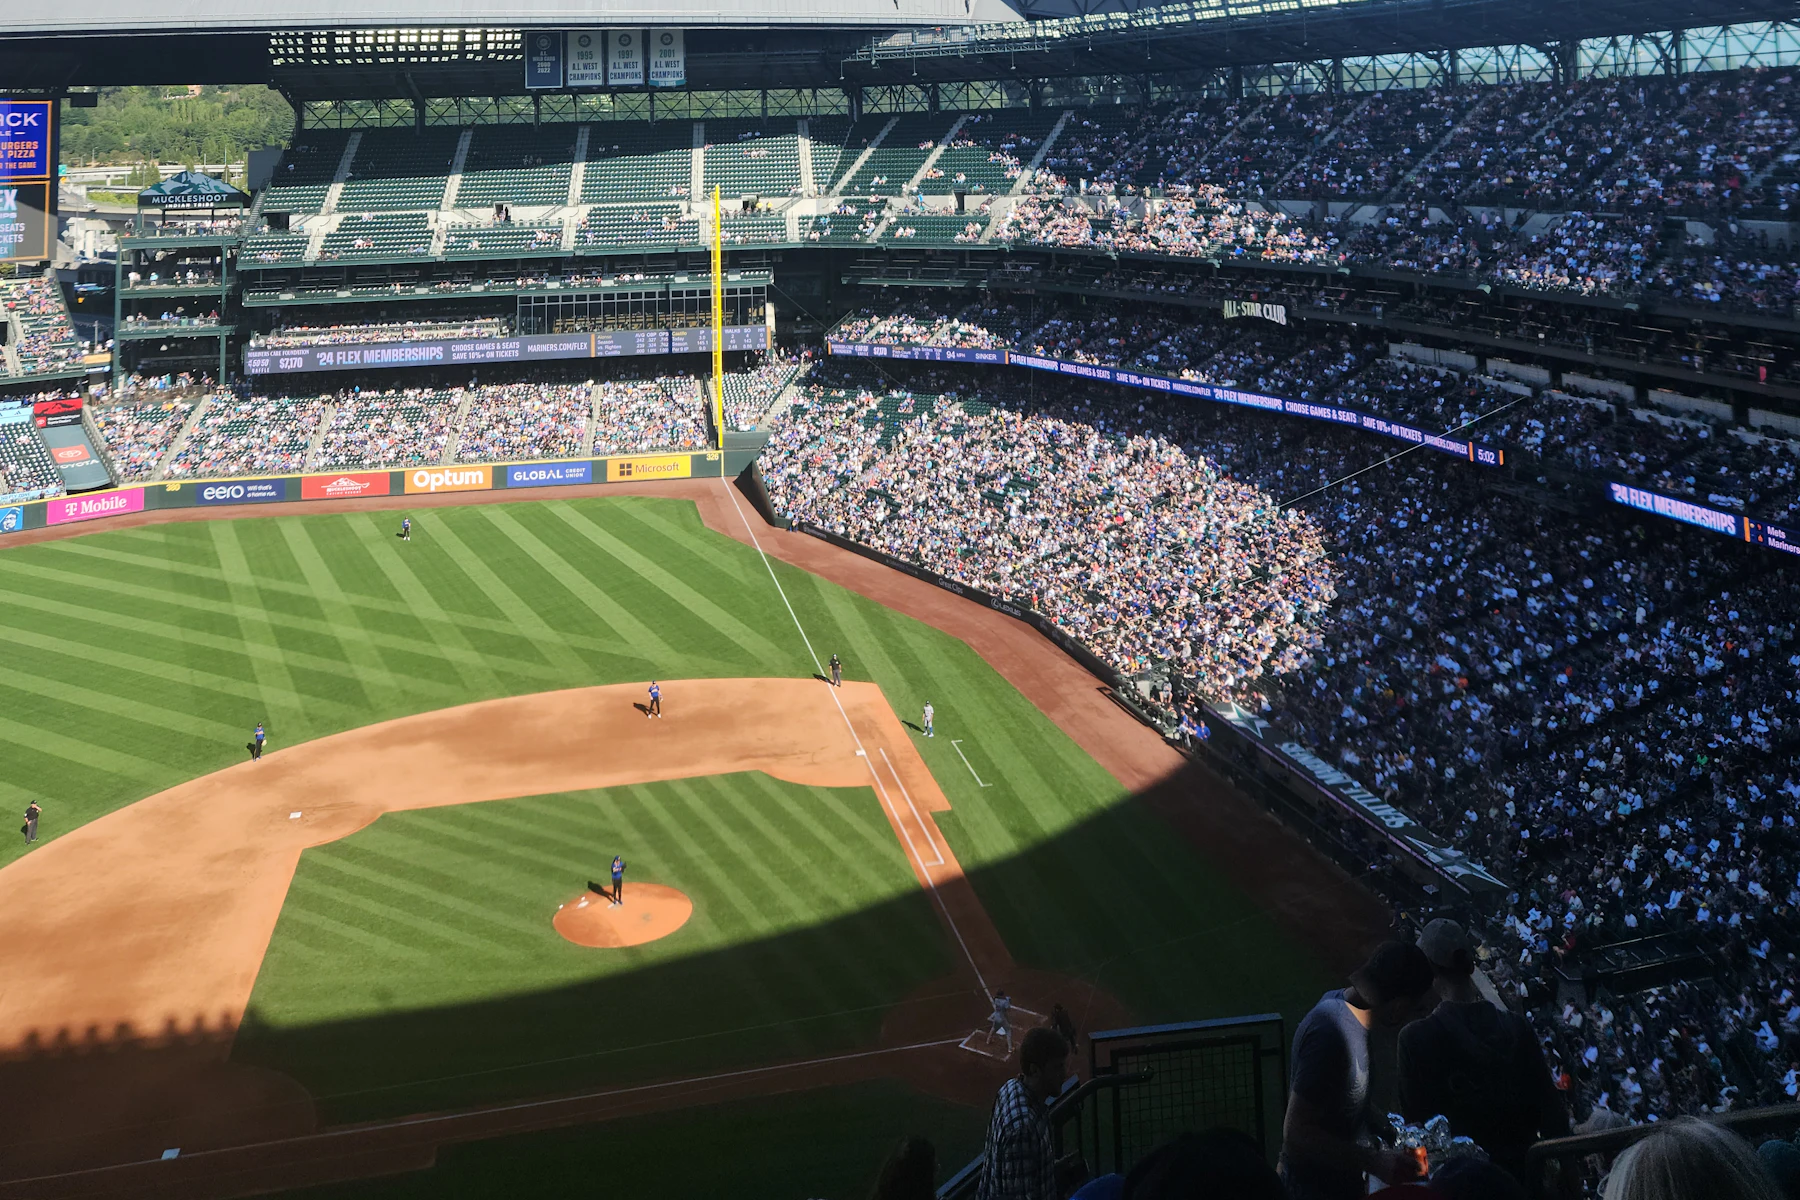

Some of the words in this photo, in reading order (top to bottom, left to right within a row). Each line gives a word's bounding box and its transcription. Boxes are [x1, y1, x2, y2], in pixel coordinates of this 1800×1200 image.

[577, 51, 593, 60] 1995
[618, 50, 633, 59] 1997
[659, 49, 675, 58] 2001
[583, 62, 598, 70] WEST
[623, 61, 638, 69] WEST
[664, 60, 680, 68] WEST
[569, 72, 601, 81] CHAMPIONS
[610, 71, 642, 80] CHAMPIONS
[651, 70, 683, 79] CHAMPIONS
[8, 150, 35, 158] PIZZA
[151, 194, 228, 204] MUCKLESHOOT
[1263, 303, 1287, 325] CLUB
[451, 344, 474, 352] CHOOSE
[475, 343, 495, 351] GAMES
[528, 342, 588, 352] MARINERS.COM/FLEX
[337, 350, 361, 365] FLEX
[364, 346, 443, 364] MEMBERSHIPS
[946, 350, 955, 359] 94
[975, 352, 997, 360] SINKER
[279, 357, 303, 369] $7,170
[1027, 357, 1058, 371] MEMBERSHIPS
[1060, 363, 1076, 374] CHOOSE
[1077, 365, 1092, 376] GAMES
[1096, 369, 1110, 379] SEATS
[1116, 372, 1128, 382] SAVE
[1143, 376, 1150, 386] ON
[1150, 377, 1170, 389] TICKETS
[1223, 390, 1237, 402] FLEX
[1238, 392, 1283, 411] MEMBERSHIPS
[1285, 402, 1309, 414] CHOOSE
[1310, 406, 1331, 419] GAMES
[1332, 410, 1337, 419] &
[1338, 410, 1356, 424] SEATS
[1363, 416, 1375, 429] SAVE
[1391, 424, 1400, 435] ON
[1400, 426, 1422, 443] TICKETS
[706, 453, 719, 461] 326
[1477, 448, 1495, 464] 5:02
[635, 462, 680, 473] Microsoft
[413, 469, 483, 491] Optum
[513, 469, 563, 481] GLOBAL
[203, 485, 244, 500] eero
[65, 502, 77, 516] T
[80, 497, 126, 514] Mobile
[1629, 488, 1653, 511] FLEX
[1654, 494, 1736, 535] MEMBERSHIPS
[1767, 525, 1786, 539] Mets
[1768, 537, 1800, 555] Mariners
[938, 577, 952, 590] Great
[952, 583, 963, 594] Clips
